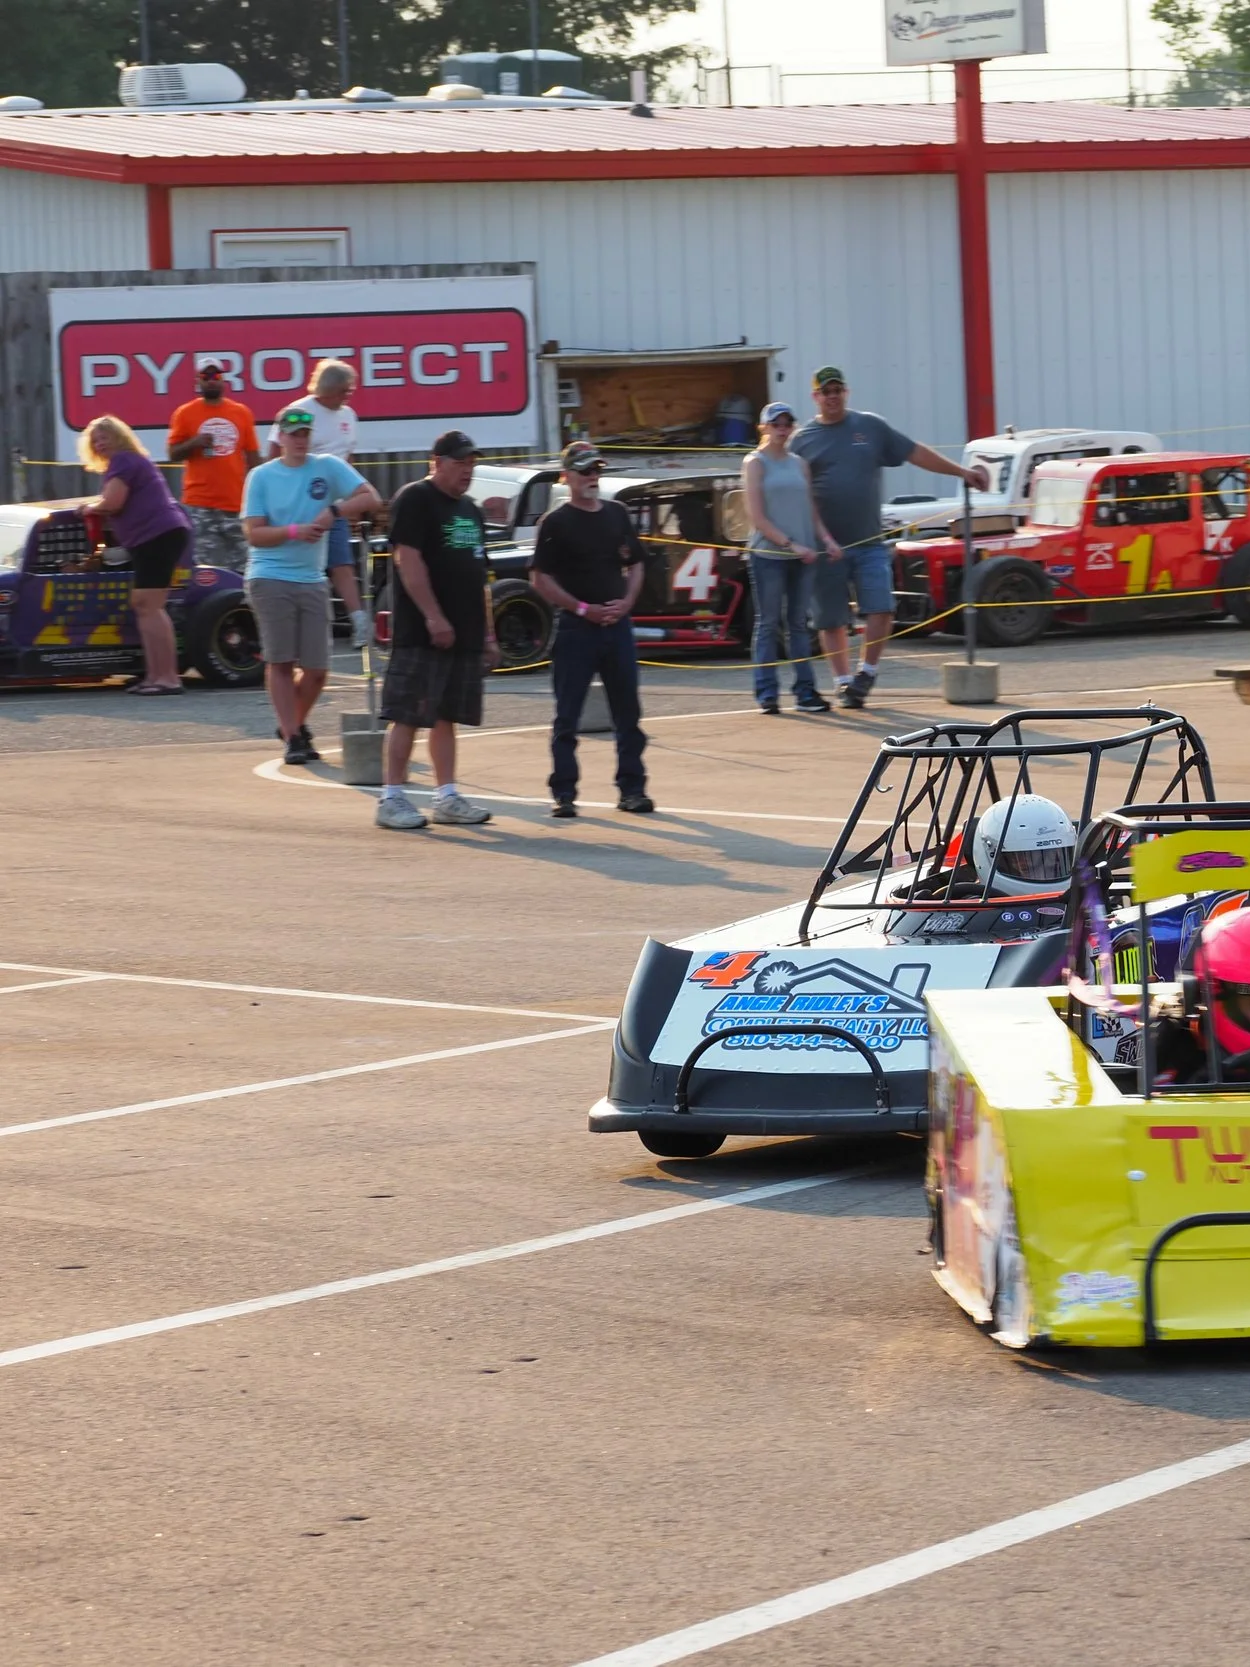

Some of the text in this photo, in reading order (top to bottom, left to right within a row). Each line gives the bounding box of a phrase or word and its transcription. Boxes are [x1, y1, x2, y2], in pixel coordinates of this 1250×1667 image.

[1116, 534, 1154, 595] 1
[671, 547, 720, 602] 4
[1035, 838, 1063, 848] zamp
[717, 994, 890, 1013] ANGIE RIDLEY'S
[725, 1033, 900, 1049] 810-744-400
